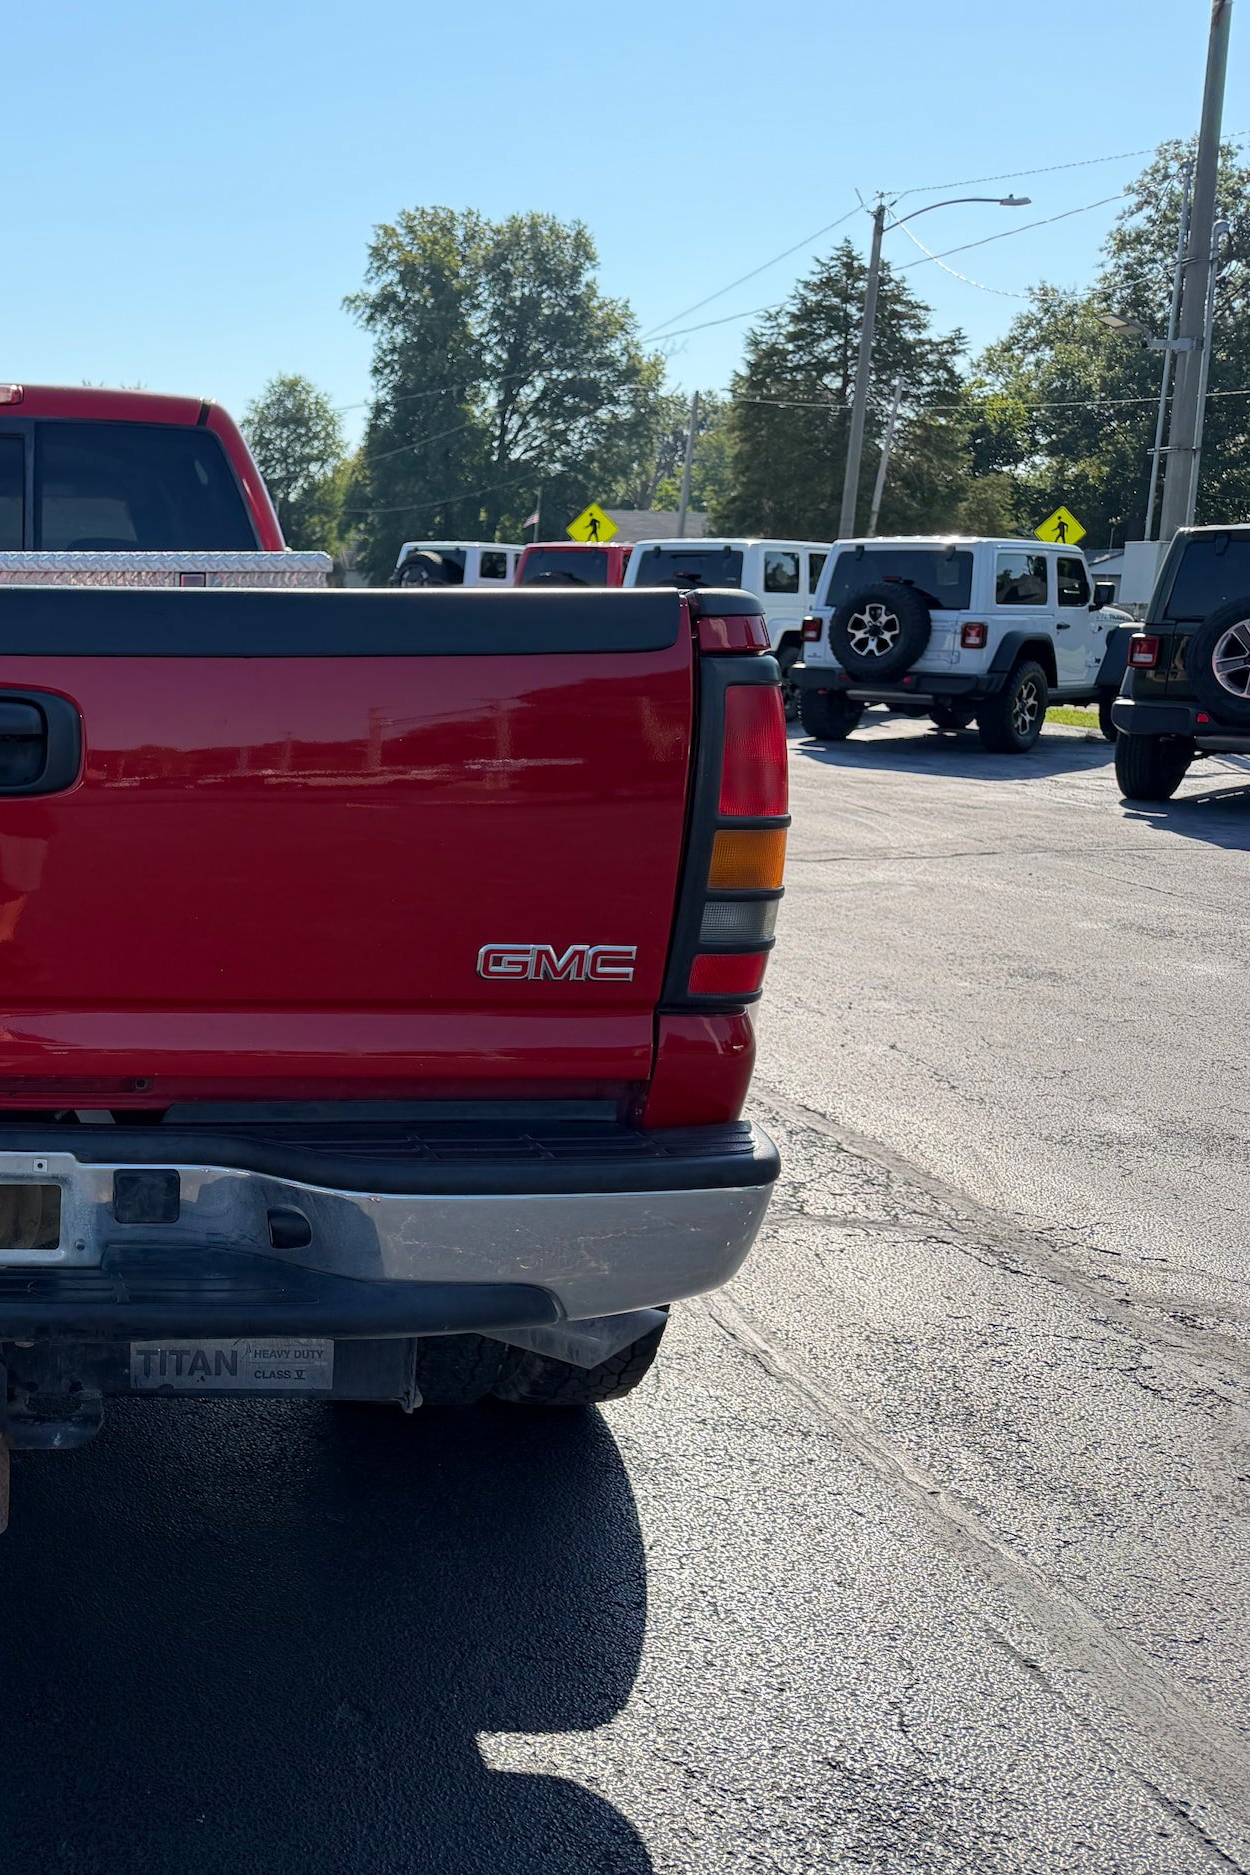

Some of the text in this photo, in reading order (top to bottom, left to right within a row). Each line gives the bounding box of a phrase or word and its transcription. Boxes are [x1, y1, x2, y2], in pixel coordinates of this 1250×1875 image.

[477, 943, 638, 982] GMC
[136, 1349, 238, 1377] TITAN
[253, 1349, 324, 1359] HEAVY DUTY
[254, 1369, 306, 1380] CLASS V
